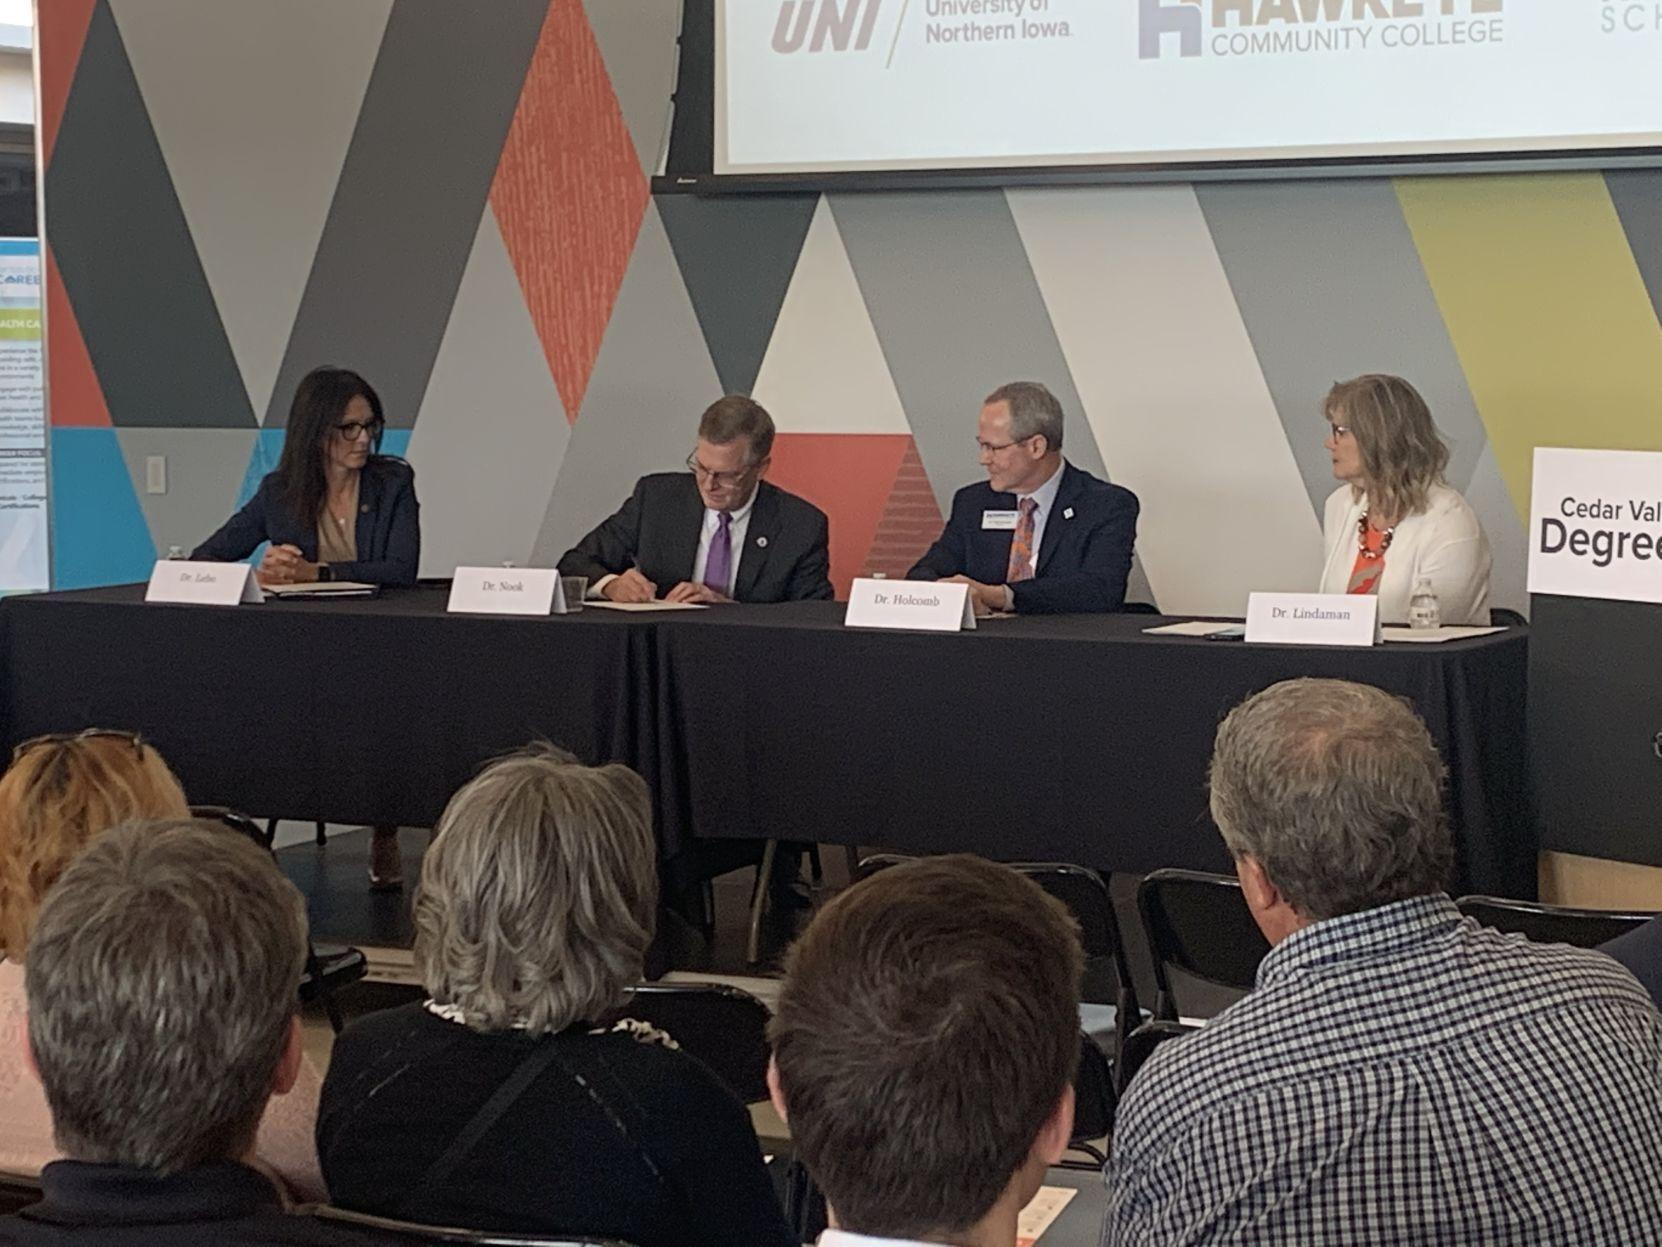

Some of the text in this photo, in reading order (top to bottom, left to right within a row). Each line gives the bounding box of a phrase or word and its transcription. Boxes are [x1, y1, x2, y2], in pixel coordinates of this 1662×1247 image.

[925, 0, 1024, 17] University
[1211, 0, 1503, 28] HAWK
[771, 0, 882, 54] UNI
[925, 22, 1016, 44] Northern
[1211, 19, 1504, 57] COMMUNITY COLLEGE
[1560, 496, 1662, 523] Cedar Val
[482, 581, 496, 592] Dr.
[874, 593, 941, 606] Dr. Holcomb
[1272, 607, 1351, 621] Dr. Lindaman
